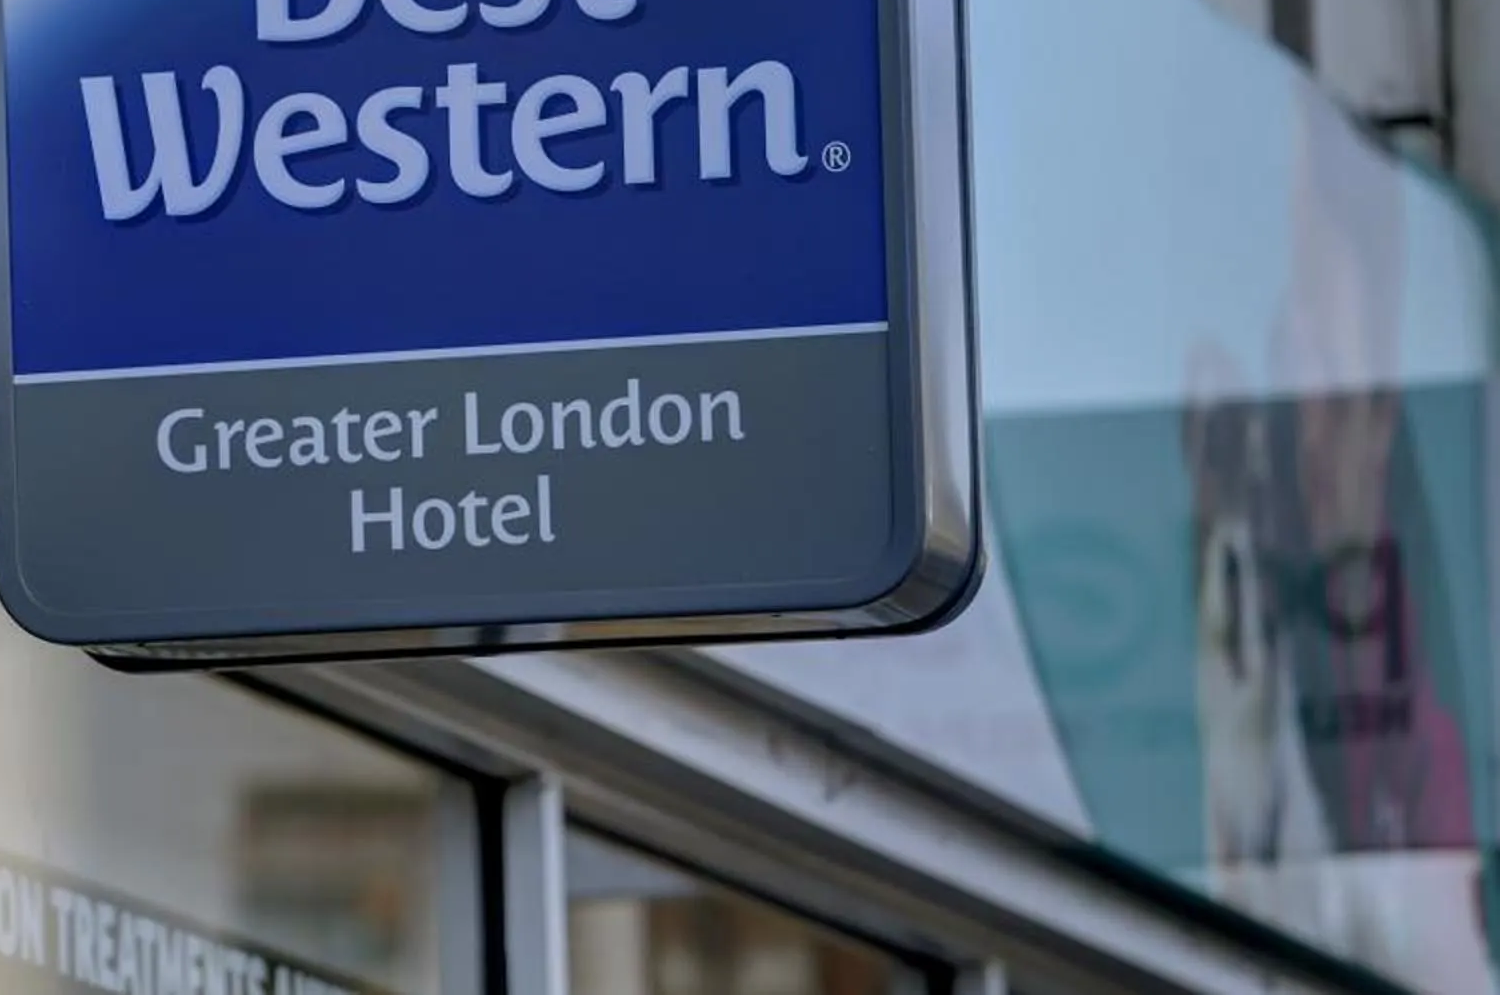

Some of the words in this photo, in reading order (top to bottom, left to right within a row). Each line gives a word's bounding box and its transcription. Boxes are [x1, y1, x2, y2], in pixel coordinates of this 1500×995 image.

[155, 400, 439, 475] Greater
[462, 377, 746, 456] London
[348, 474, 556, 554] Hotel
